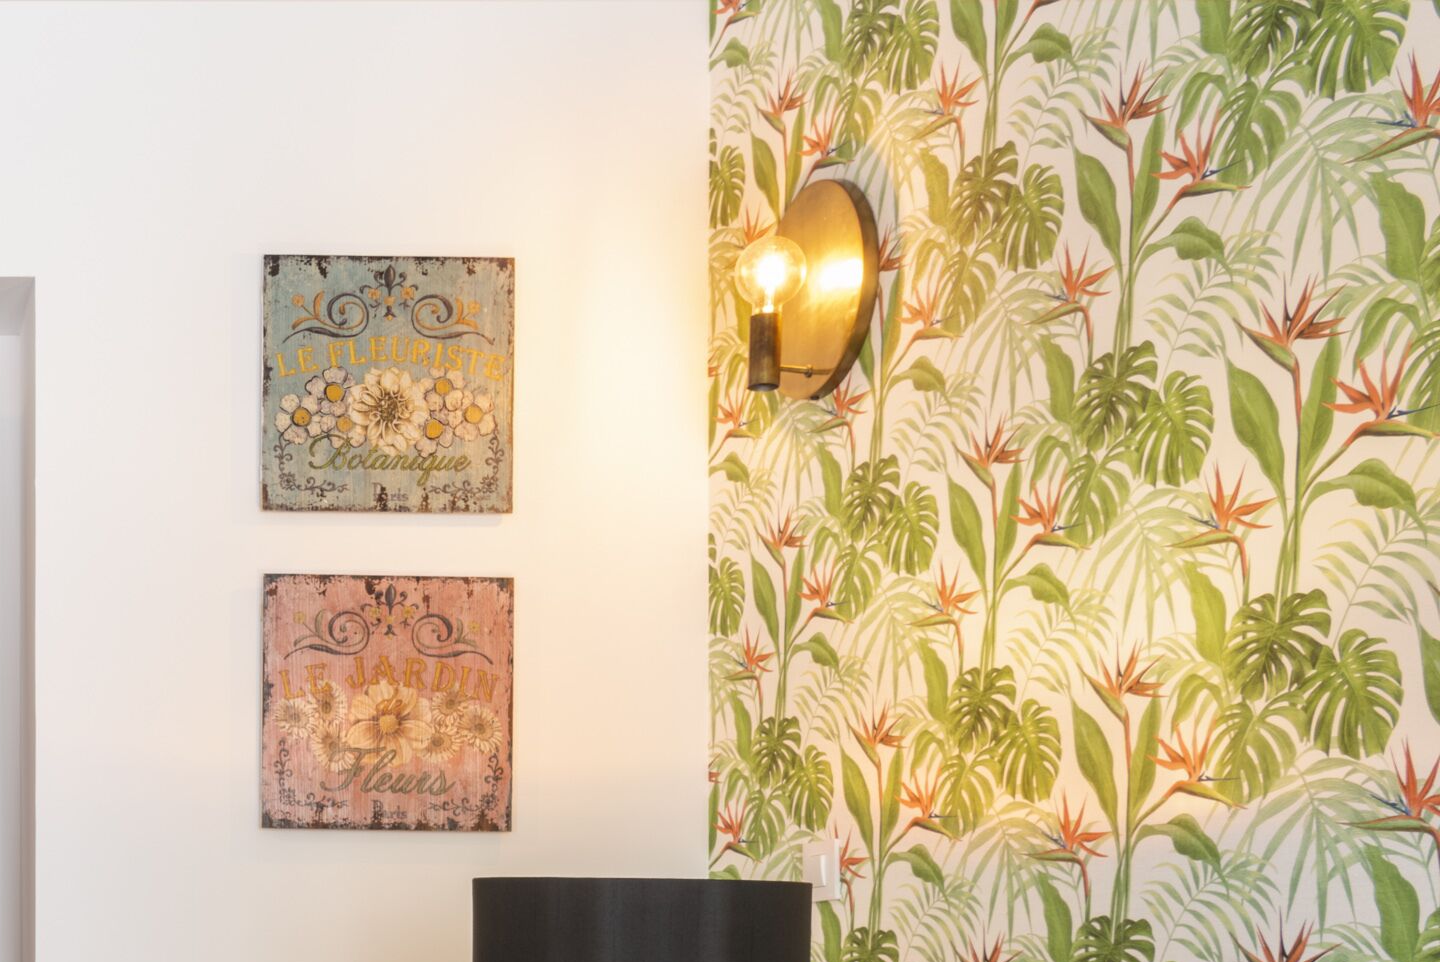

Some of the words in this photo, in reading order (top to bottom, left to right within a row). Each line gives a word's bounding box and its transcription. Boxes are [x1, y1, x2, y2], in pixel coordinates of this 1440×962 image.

[276, 347, 320, 377] LE
[327, 335, 507, 382] FLEURISTE
[309, 434, 472, 486] Botanique
[278, 662, 333, 700] LE
[345, 655, 500, 702] JARDIN
[320, 747, 456, 796] Fleurs
